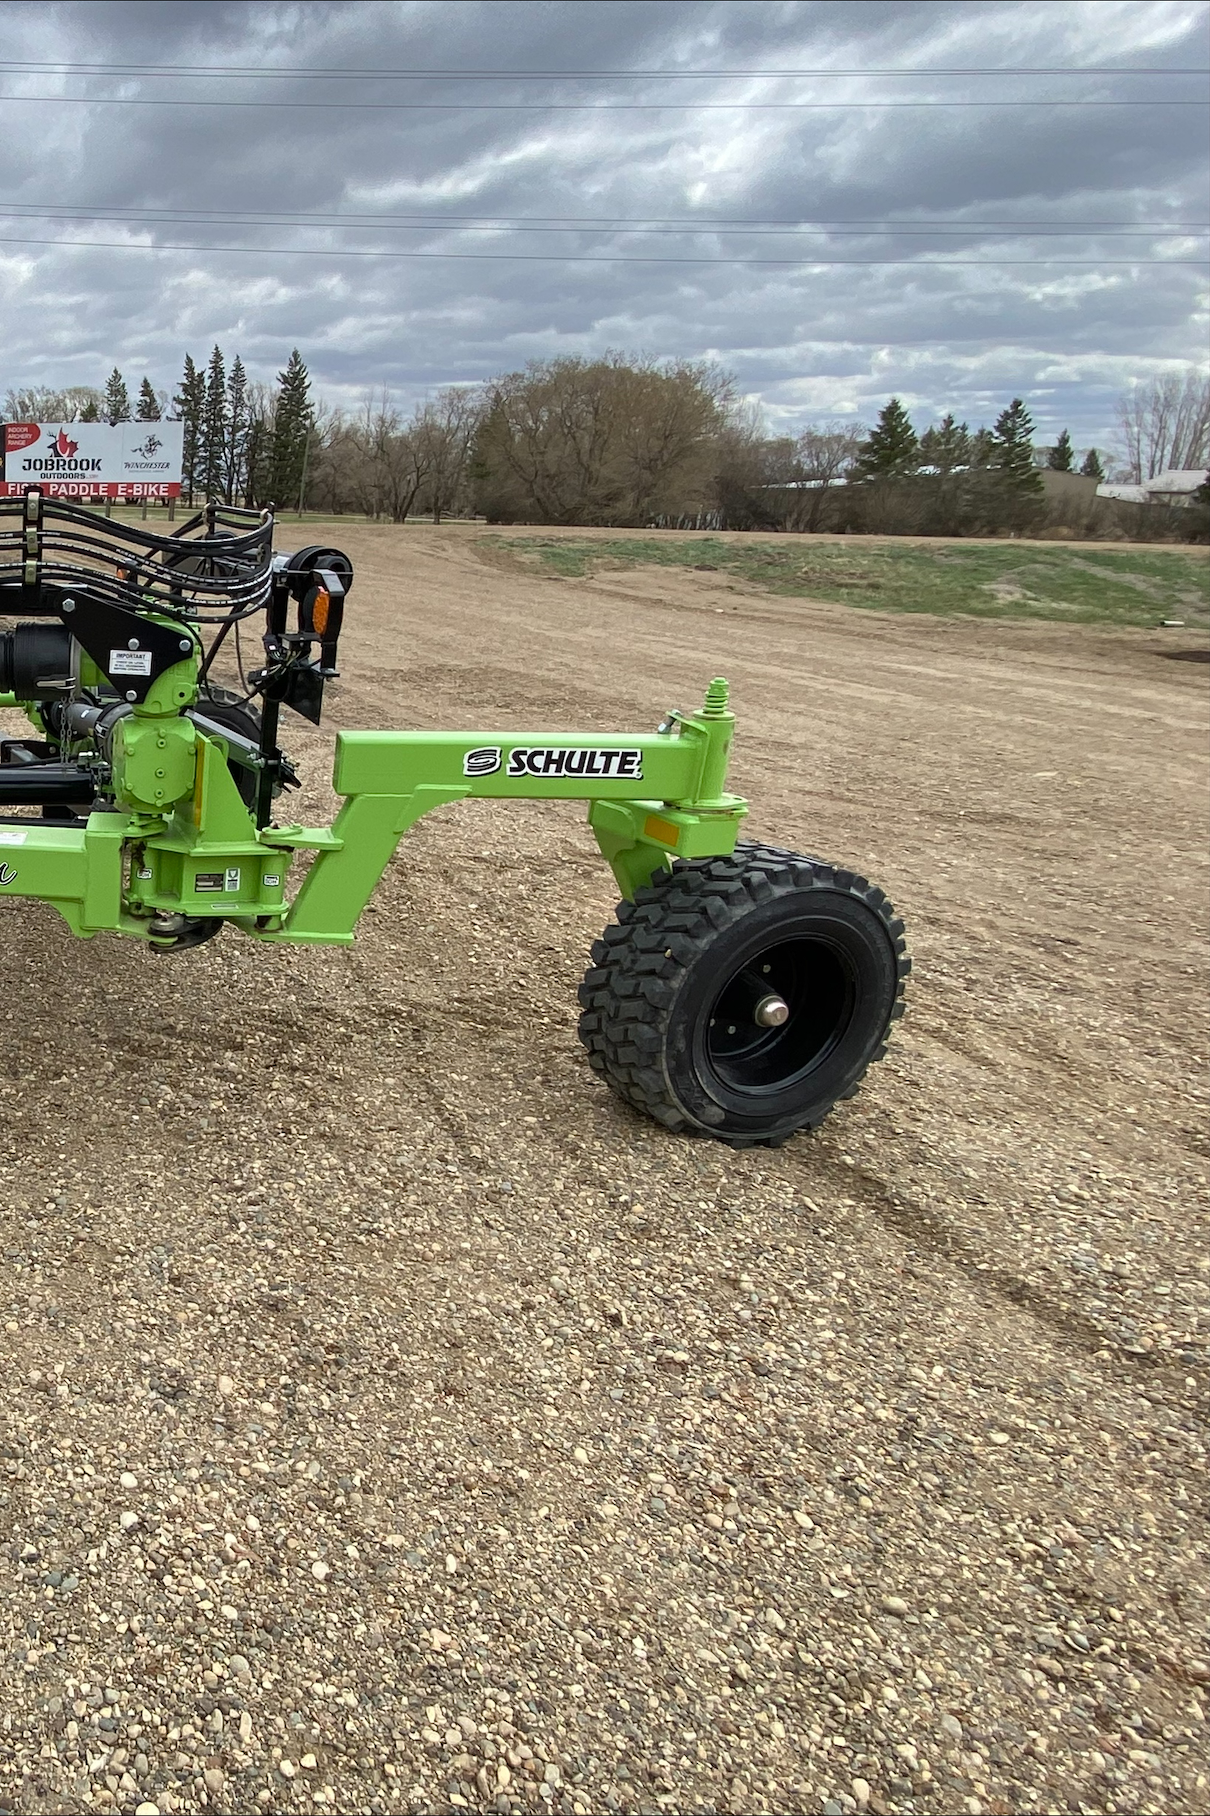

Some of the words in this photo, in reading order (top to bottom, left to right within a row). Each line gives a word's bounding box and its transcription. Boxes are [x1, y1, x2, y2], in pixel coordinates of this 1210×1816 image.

[22, 458, 103, 471] JOBROOK
[123, 461, 171, 469] WINCHESTER
[40, 472, 86, 480] OUTDOORS
[49, 483, 109, 496] PADDLE
[117, 483, 169, 496] E-BIKE
[116, 652, 146, 660] IMPORTANT
[508, 749, 639, 775] SCHULTE
